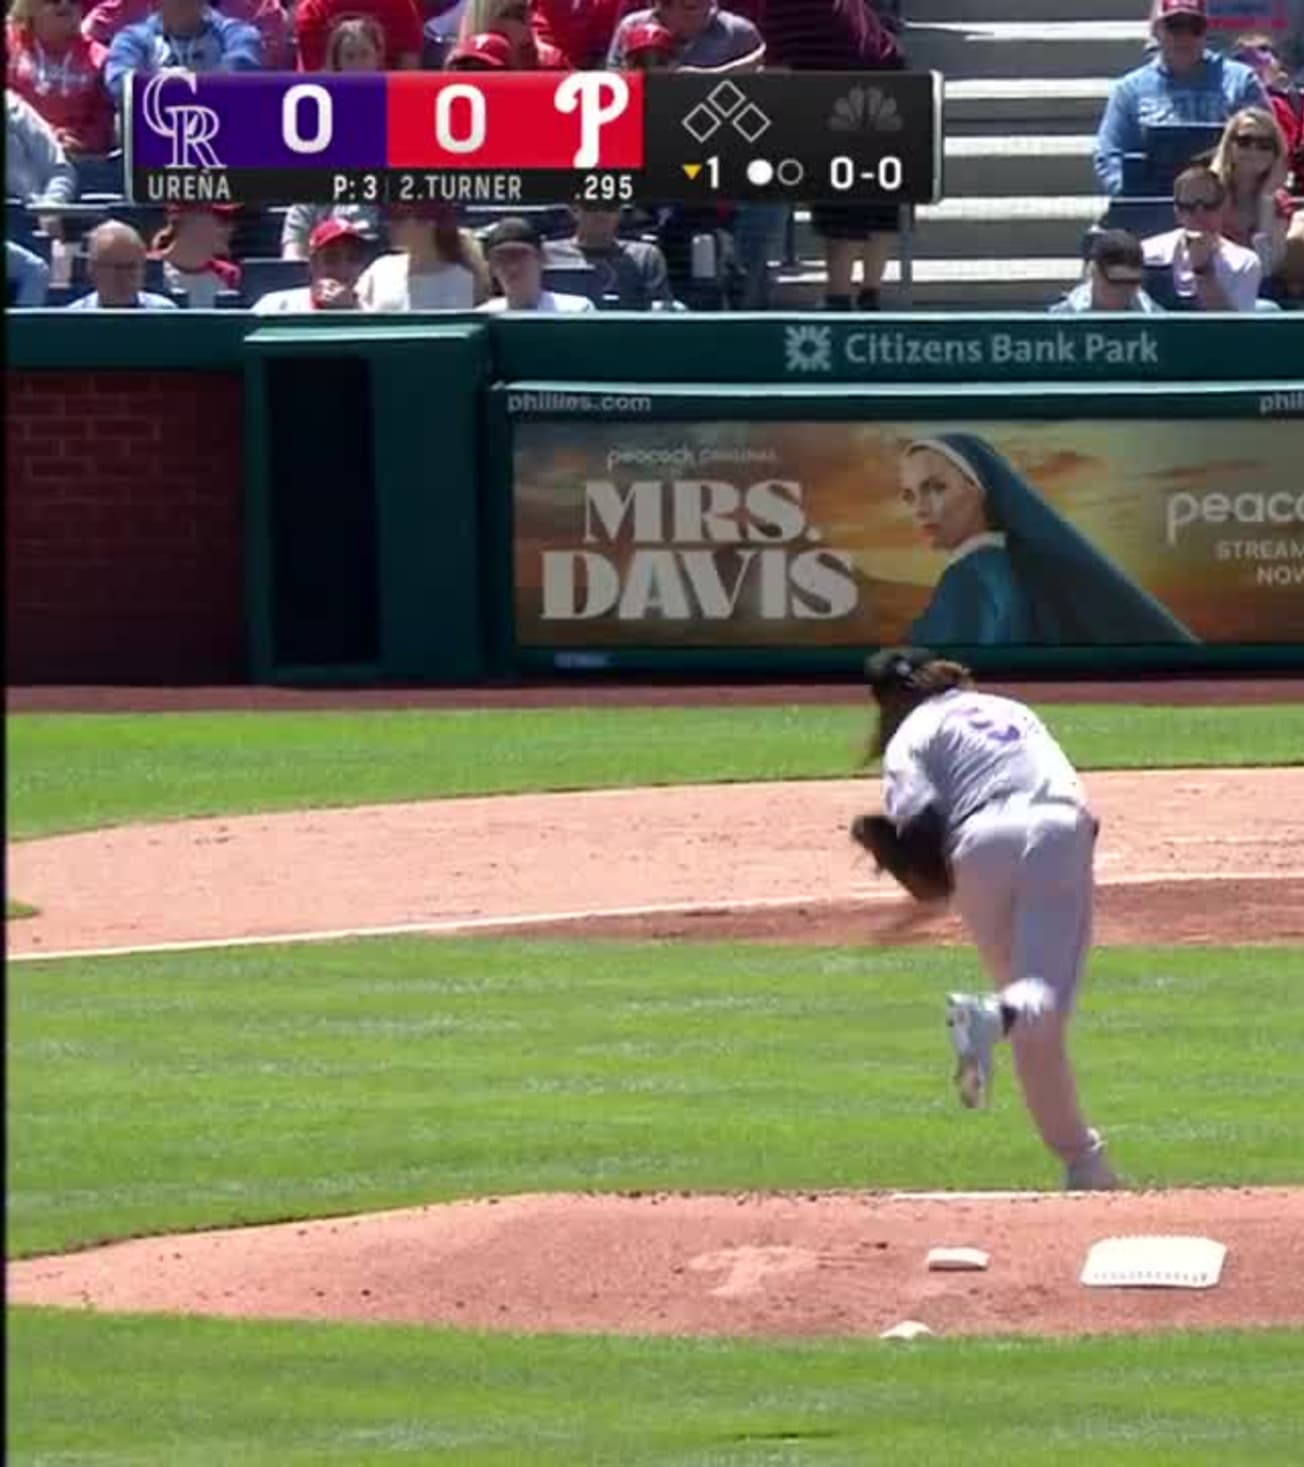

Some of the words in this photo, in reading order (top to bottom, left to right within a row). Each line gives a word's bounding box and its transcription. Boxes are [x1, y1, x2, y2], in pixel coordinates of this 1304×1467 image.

[844, 333, 983, 364] Citizens
[991, 331, 1075, 364] Bank
[1085, 331, 1159, 364] Park
[507, 391, 653, 413] phillies.com
[583, 480, 822, 543] MRS.
[541, 549, 859, 620] DAVIS
